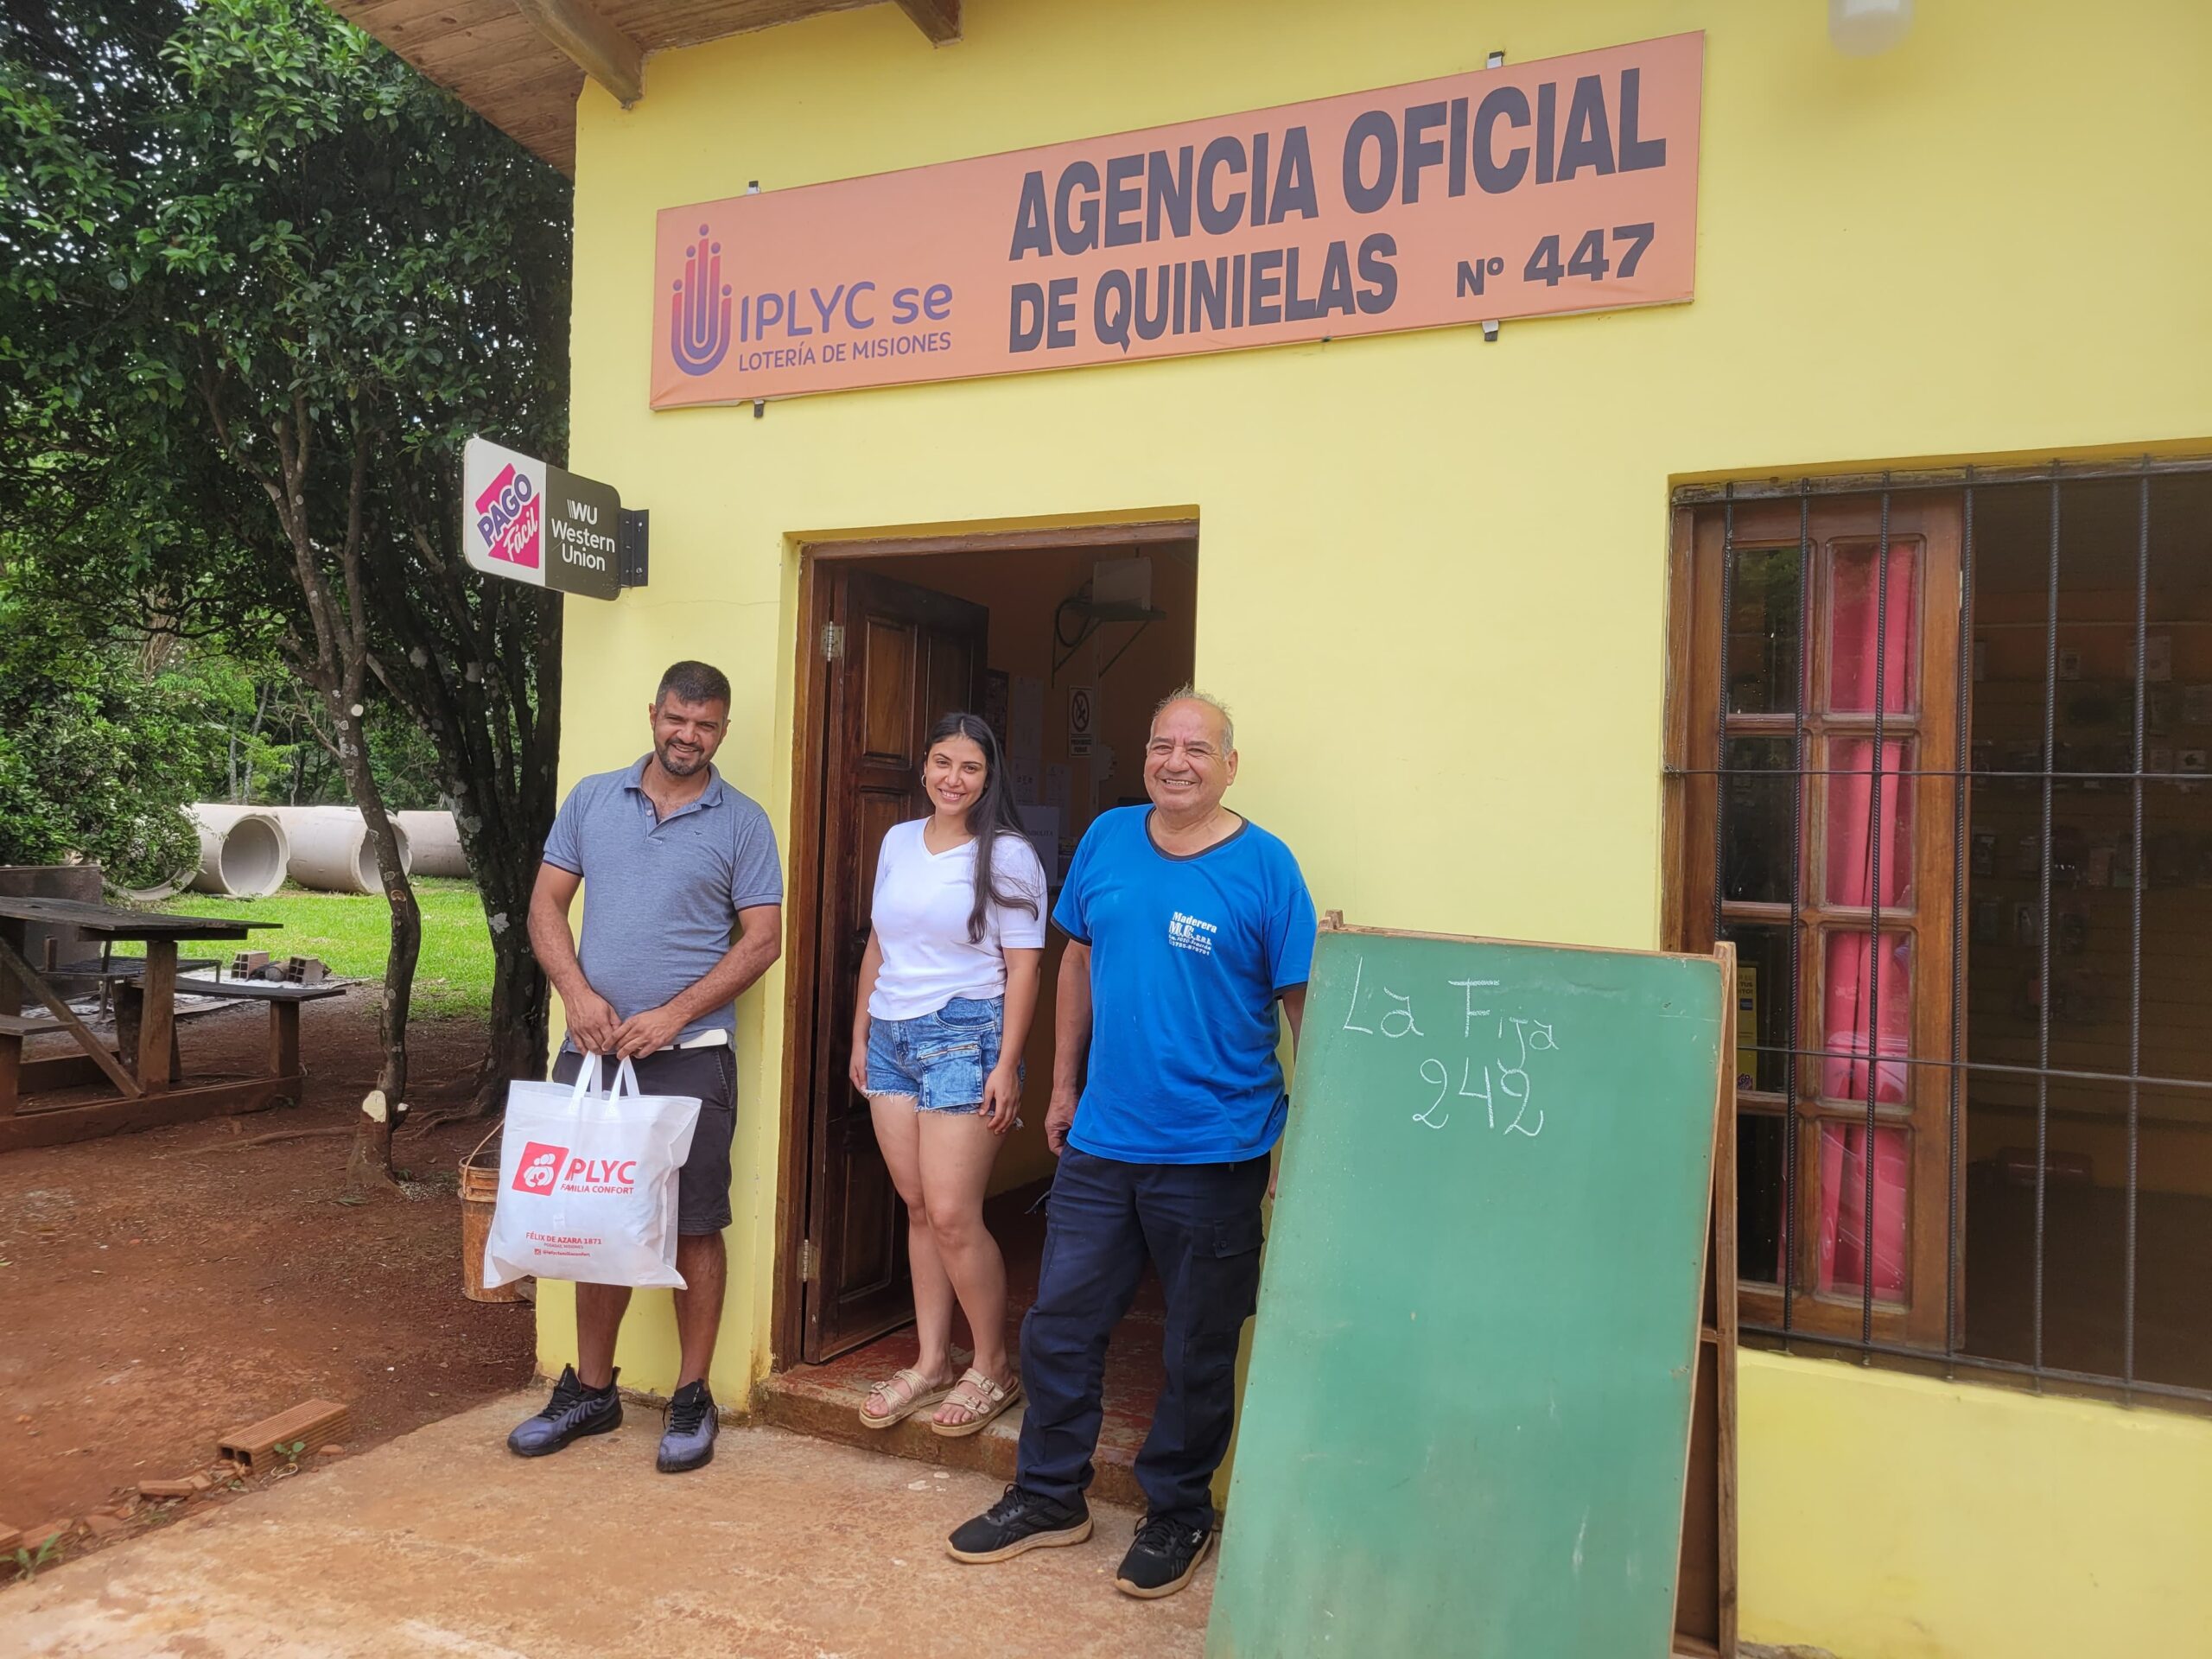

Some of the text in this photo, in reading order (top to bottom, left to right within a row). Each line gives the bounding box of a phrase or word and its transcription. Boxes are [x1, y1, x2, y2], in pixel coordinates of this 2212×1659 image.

[1009, 67, 1667, 261] AGENCIA OFICIAL
[1009, 276, 1078, 353] DE
[1093, 232, 1398, 353] QUINIELAS
[1523, 222, 1655, 287] 447
[740, 282, 952, 342] IPLYC se
[739, 332, 950, 372] LOTERÍA DE MISIONES
[477, 474, 532, 548] PAGO
[569, 499, 598, 525] WU
[551, 518, 615, 553] Western
[562, 543, 606, 571] Union
[1172, 911, 1217, 933] Maderera
[1343, 956, 1424, 1038] La
[1413, 1057, 1543, 1136] 242
[560, 1183, 634, 1195] FAMILIA CONFORT
[525, 1231, 545, 1242] FÉLIX
